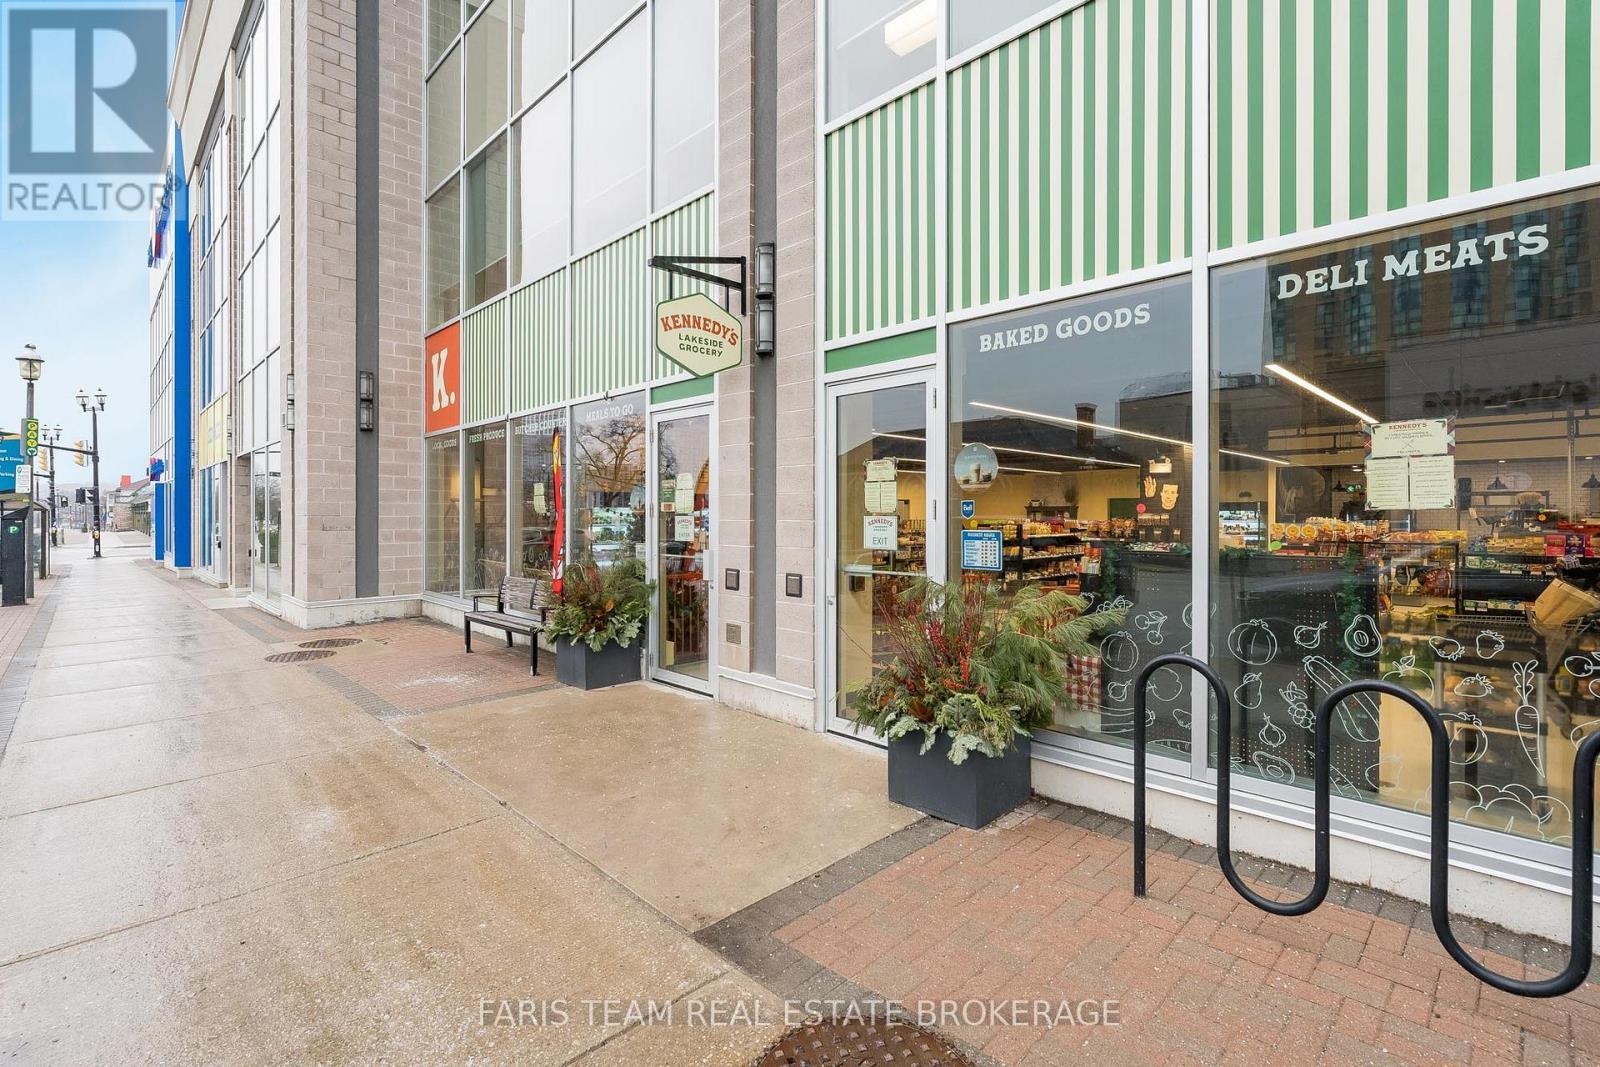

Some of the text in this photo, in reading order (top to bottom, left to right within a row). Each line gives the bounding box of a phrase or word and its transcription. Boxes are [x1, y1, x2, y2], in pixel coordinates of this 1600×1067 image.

[1277, 223, 1550, 300] DELI MEATS
[660, 314, 739, 347] KENNEDY'S
[979, 303, 1151, 353] BAKED GOODS
[679, 333, 724, 348] LAKESIDE
[679, 343, 723, 357] GROCERY
[431, 347, 456, 412] K.
[610, 406, 621, 417] TO
[623, 403, 634, 415] GO
[872, 536, 888, 545] EXIT
